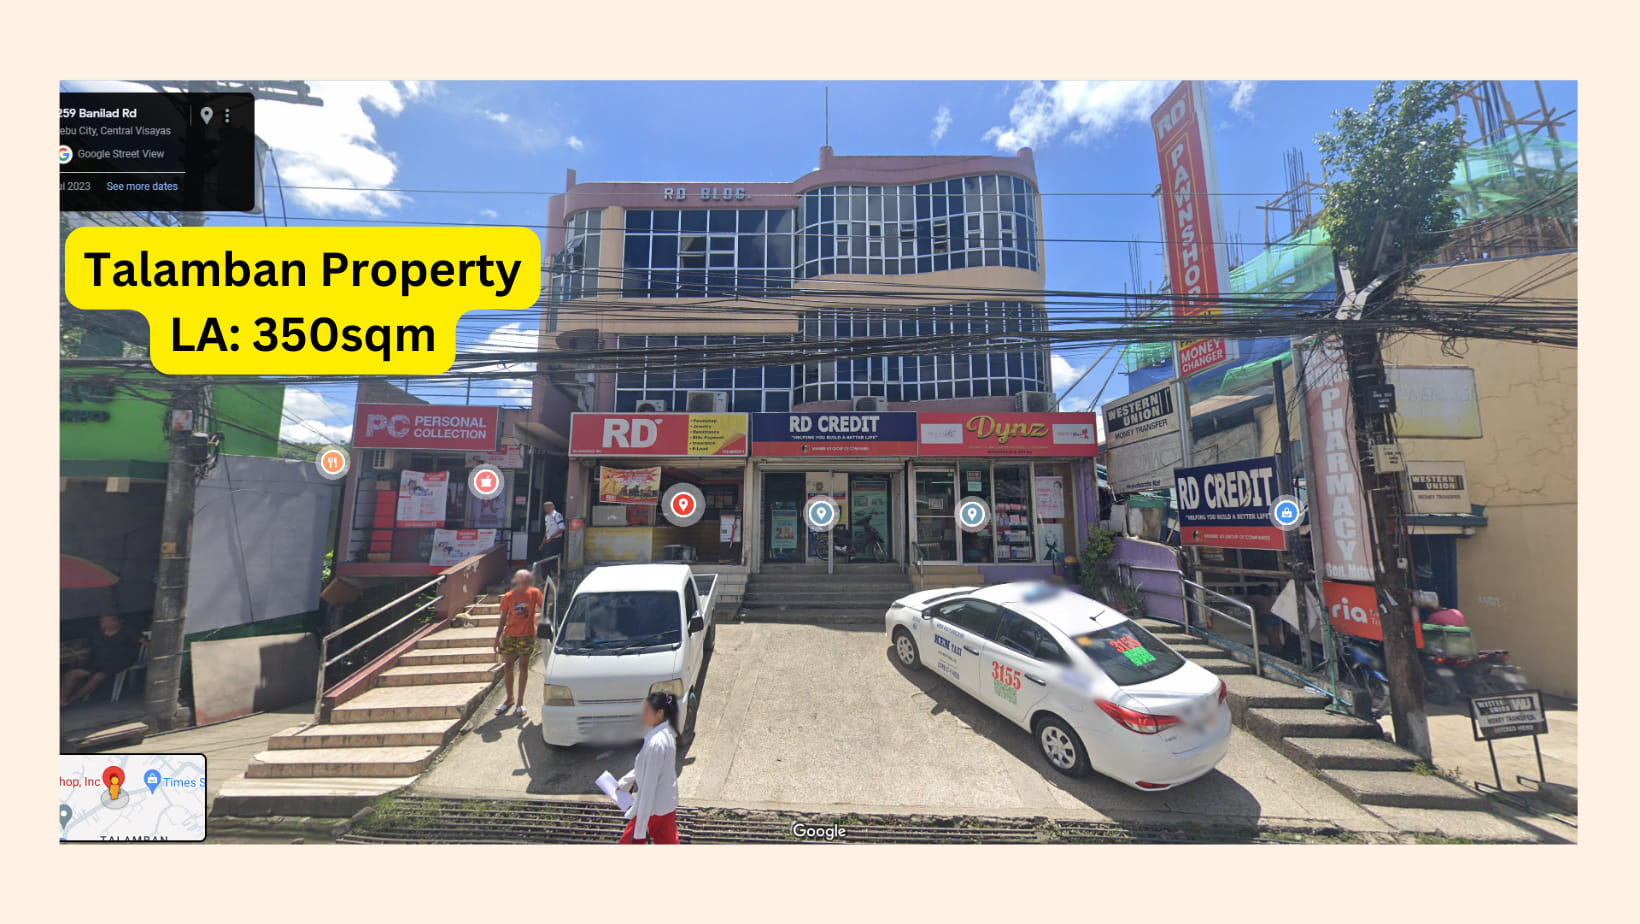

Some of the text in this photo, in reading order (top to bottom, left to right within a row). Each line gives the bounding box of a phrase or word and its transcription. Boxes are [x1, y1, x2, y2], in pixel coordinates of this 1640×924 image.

[1156, 99, 1186, 140] RD
[664, 187, 752, 201] RD BLDG.
[1170, 143, 1201, 305] PAWNSHOP
[1181, 338, 1222, 364] MONEY
[1182, 350, 1224, 373] CHANGER
[1108, 393, 1159, 421] WESTERN
[1123, 404, 1160, 426] UNION
[365, 414, 411, 438] PC
[413, 428, 487, 440] COLLECTION
[414, 416, 487, 428] PERSONAL
[602, 418, 658, 448] RD
[789, 415, 880, 432] RD CREDIT
[966, 415, 1050, 444] Dynz
[1114, 419, 1168, 440] MONEY TRANSFER
[1320, 387, 1356, 561] PHARMACY
[1426, 482, 1456, 490] UNION
[1177, 467, 1272, 510] RD CREDIT
[1332, 597, 1368, 624] ria
[1109, 636, 1142, 654] 3155
[992, 660, 1022, 690] 3155
[1477, 700, 1504, 708] WESTER
